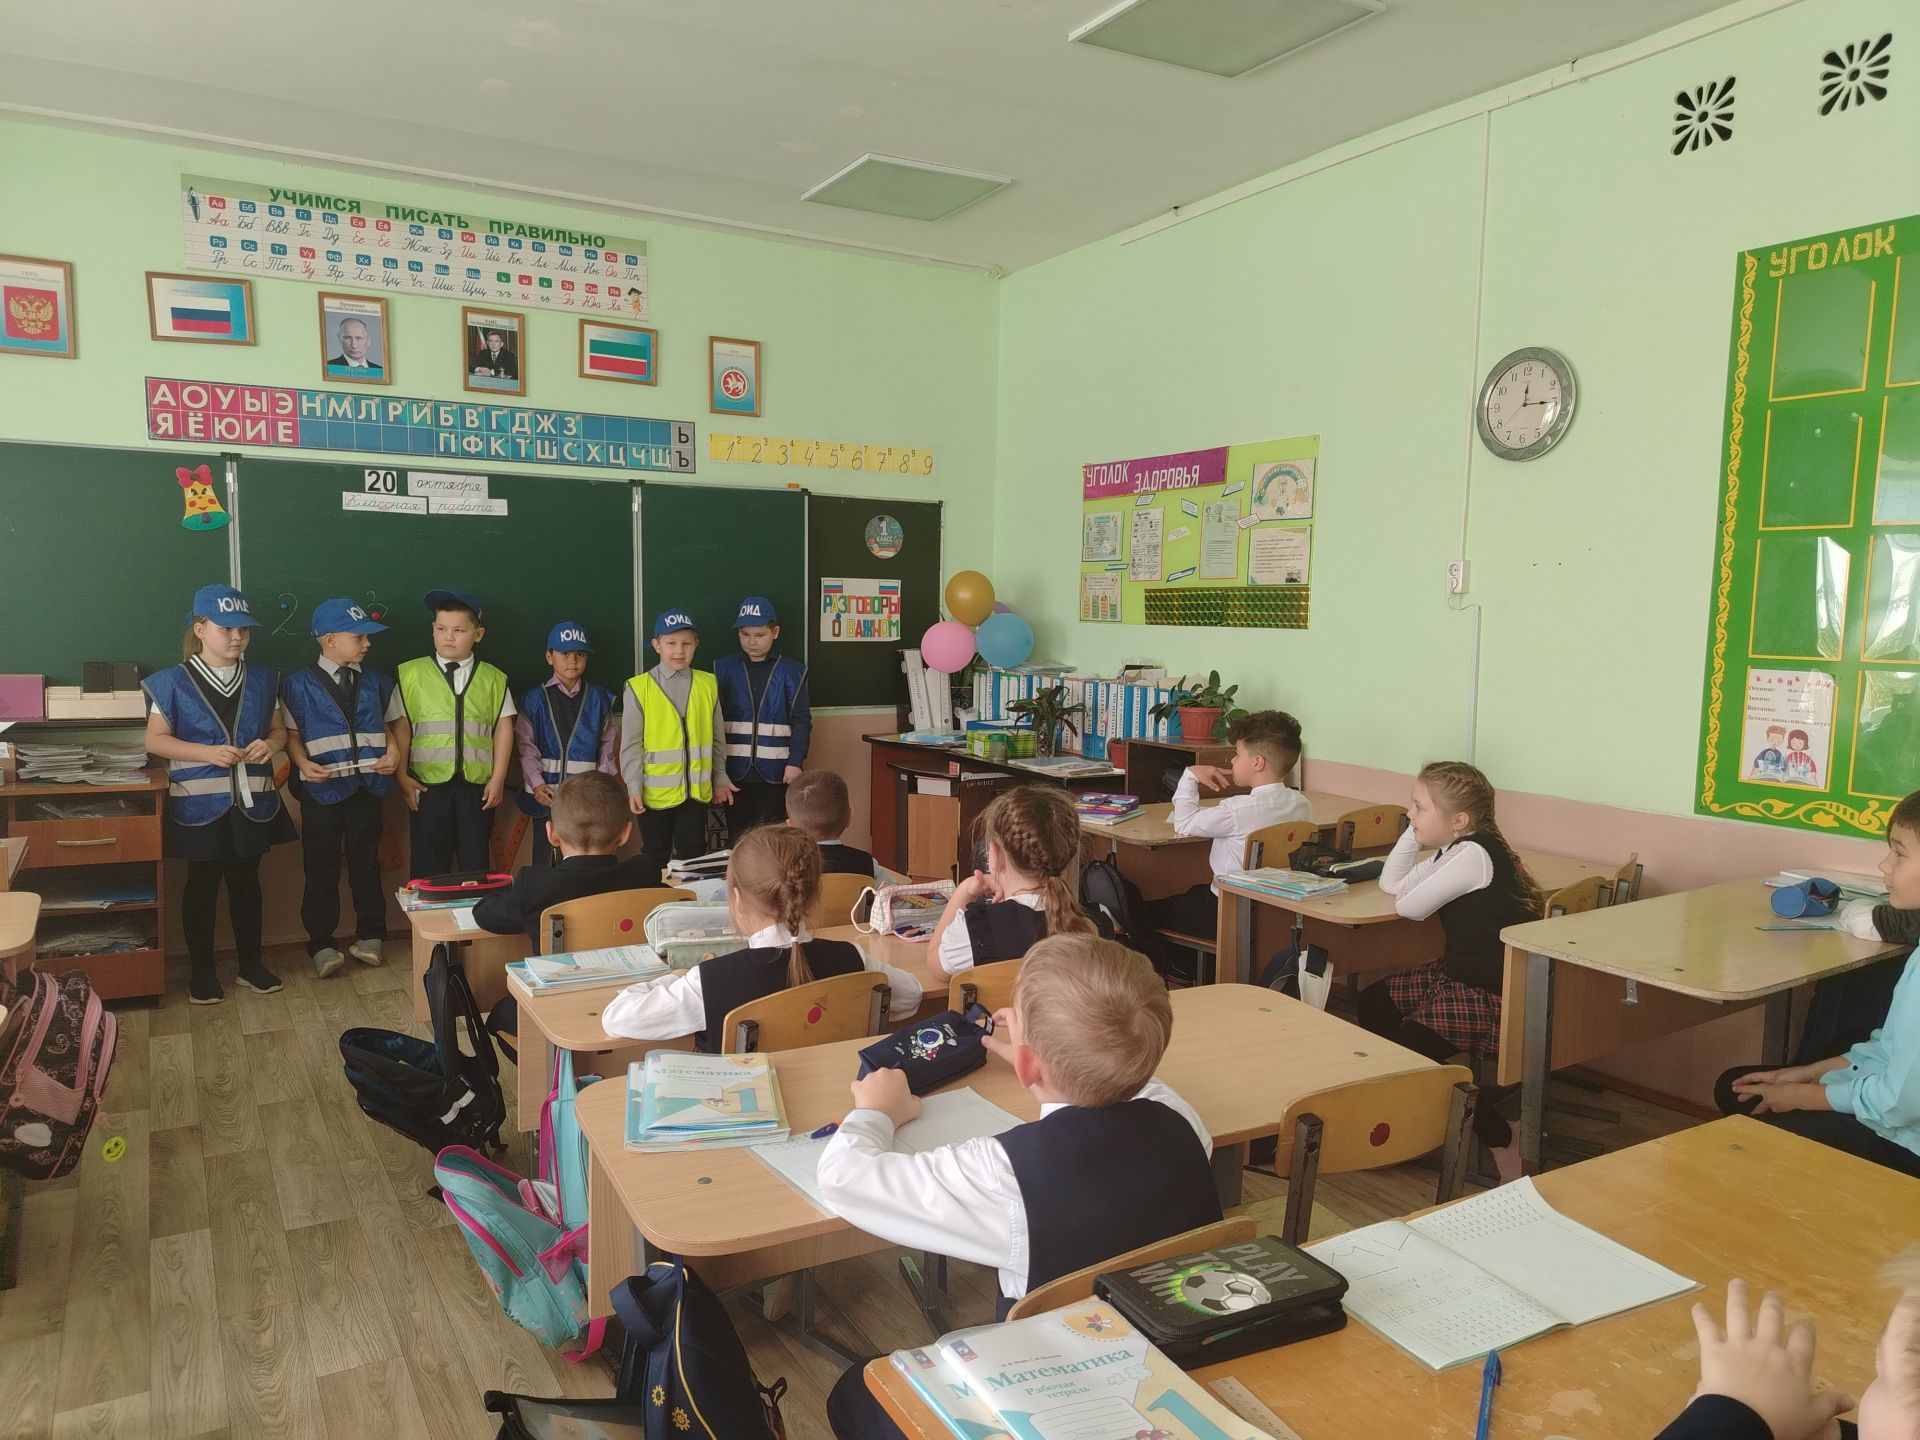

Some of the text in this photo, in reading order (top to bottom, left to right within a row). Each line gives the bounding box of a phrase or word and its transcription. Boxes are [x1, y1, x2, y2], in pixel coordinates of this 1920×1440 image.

[269, 188, 606, 248] УЧИМСЯ ПИСАТЬ ПРАВИЛЬНО
[1769, 224, 1897, 278] УГОЛОК
[726, 441, 933, 475] 1 2 3 4 5 6 7 8 9
[367, 470, 483, 497] 20 октября
[1086, 462, 1200, 493] УГОЛОК ЗДОРОВЬЯ
[345, 494, 495, 512] Классная работа
[880, 521, 888, 536] 1
[271, 592, 299, 636] 2
[823, 594, 900, 615] РАЗГОВОРЫ
[664, 614, 693, 627] ЮИД
[832, 618, 900, 639] О ВАЖНОМ
[560, 629, 587, 643] ЮИД
[1218, 1243, 1310, 1285] PLAY
[1128, 1262, 1188, 1306] WIN
[985, 1349, 1135, 1393] Математика
[1024, 1380, 1077, 1397] Рабочая
[1046, 1386, 1091, 1400] тетрадь
